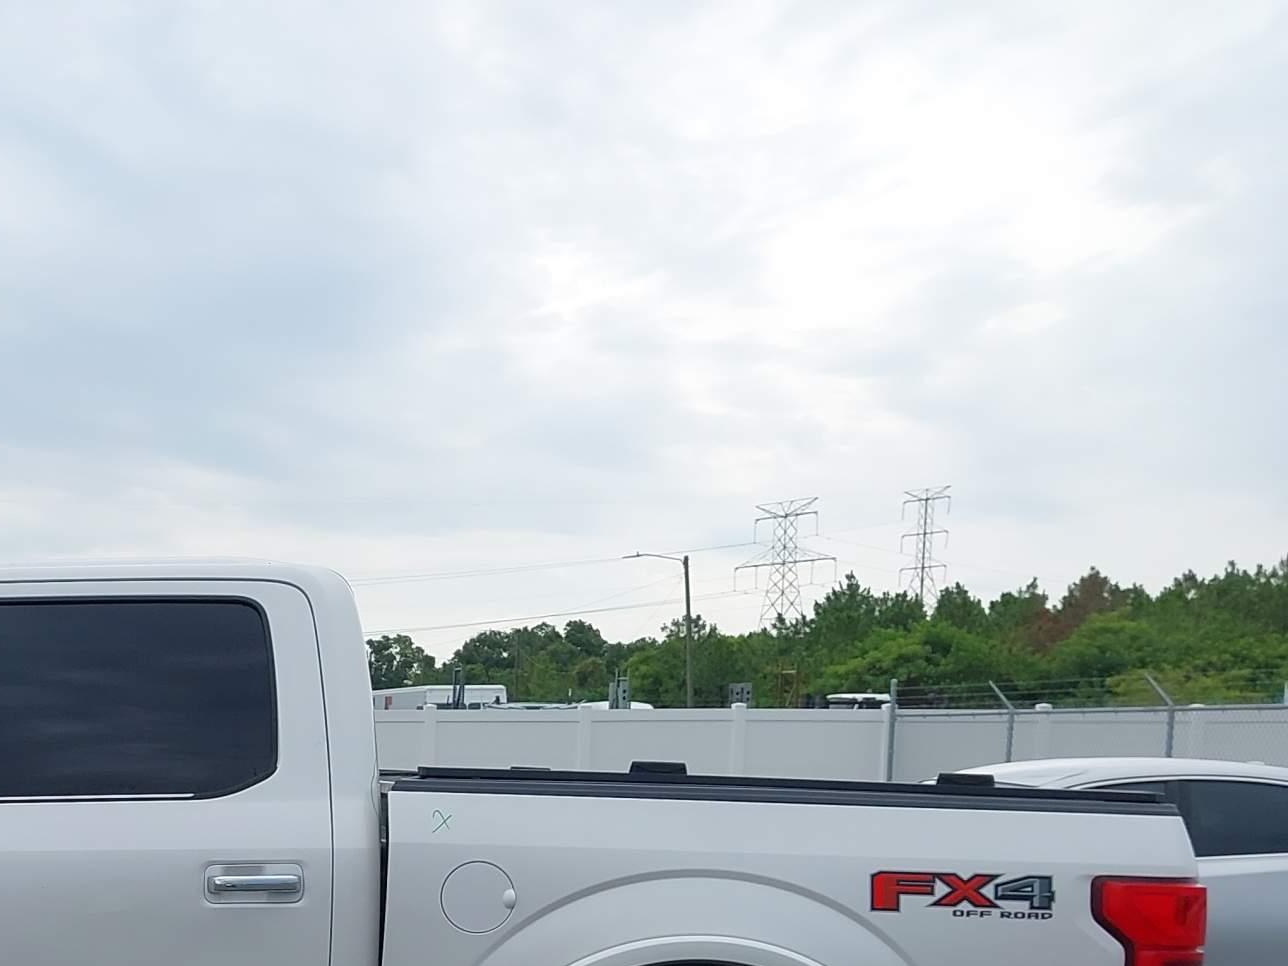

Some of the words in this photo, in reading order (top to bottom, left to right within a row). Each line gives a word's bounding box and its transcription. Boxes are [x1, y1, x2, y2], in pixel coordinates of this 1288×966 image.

[870, 871, 1056, 912] FX4
[952, 909, 993, 918] OFF
[1000, 911, 1053, 920] ROAD
